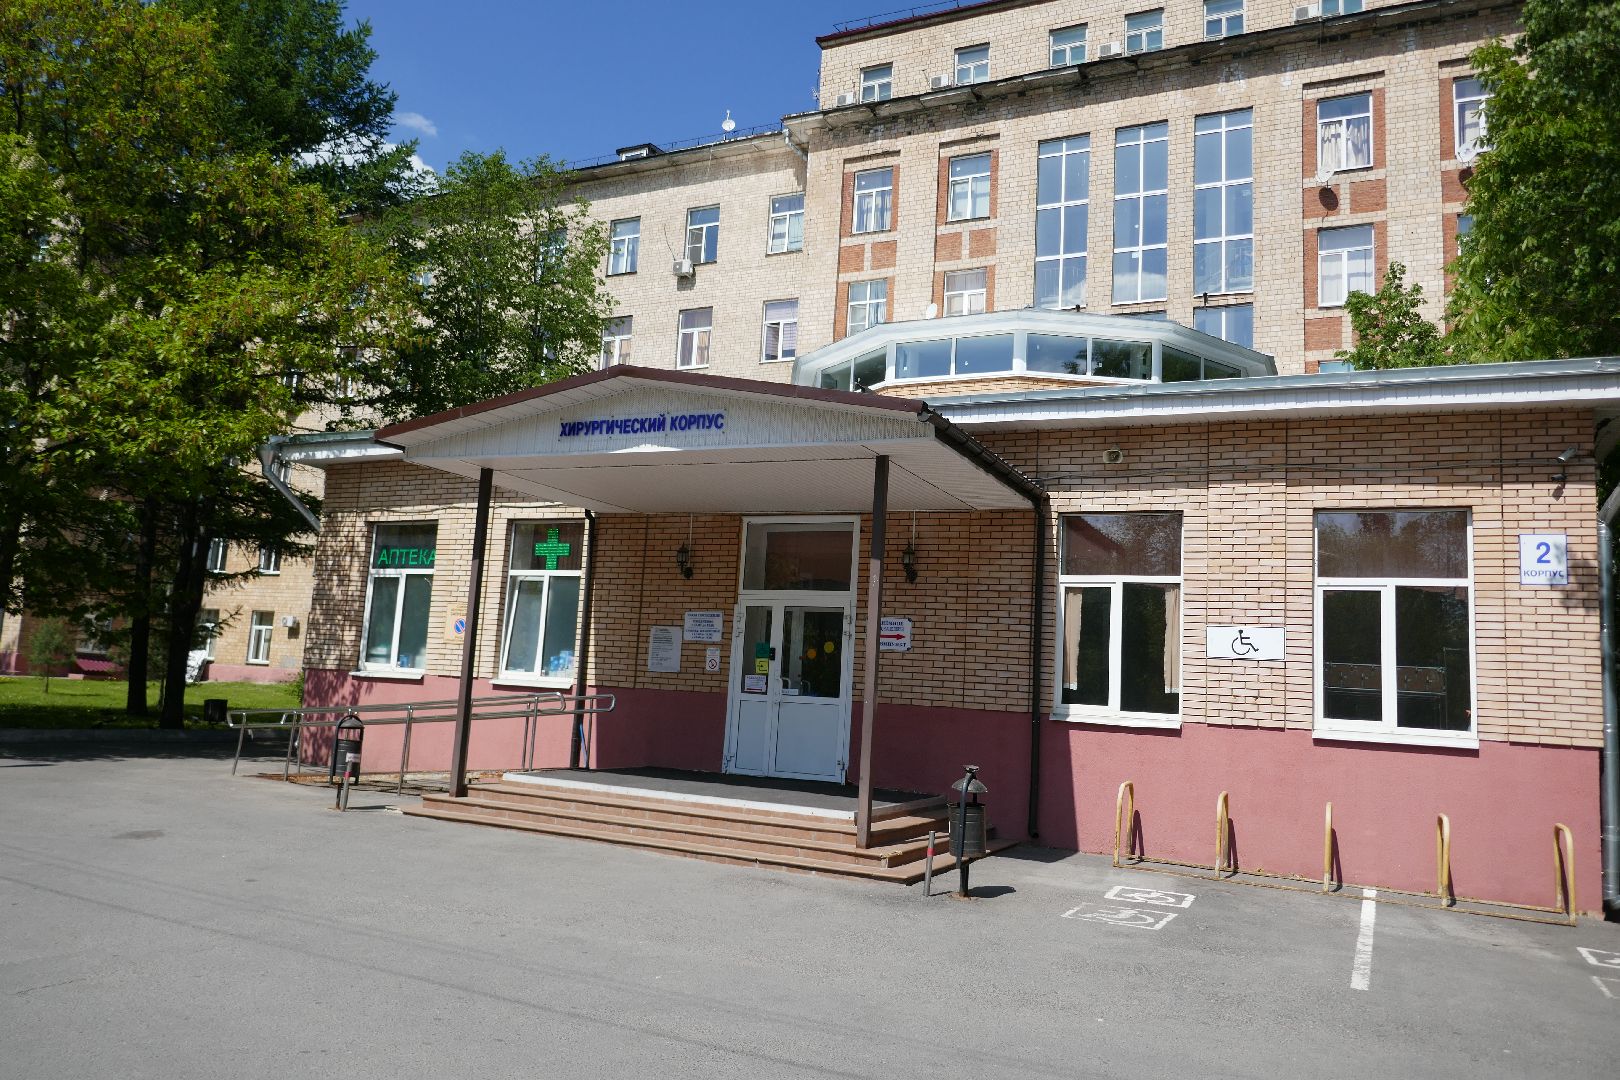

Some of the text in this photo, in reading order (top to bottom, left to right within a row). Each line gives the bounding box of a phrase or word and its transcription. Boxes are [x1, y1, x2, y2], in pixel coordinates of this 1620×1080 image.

[559, 412, 725, 437] ХИРУРГИЧЕСКИЙ КОРПУС
[377, 548, 437, 566] АПТЕКА
[1536, 541, 1551, 564] 2
[1523, 569, 1565, 578] КОРПУС
